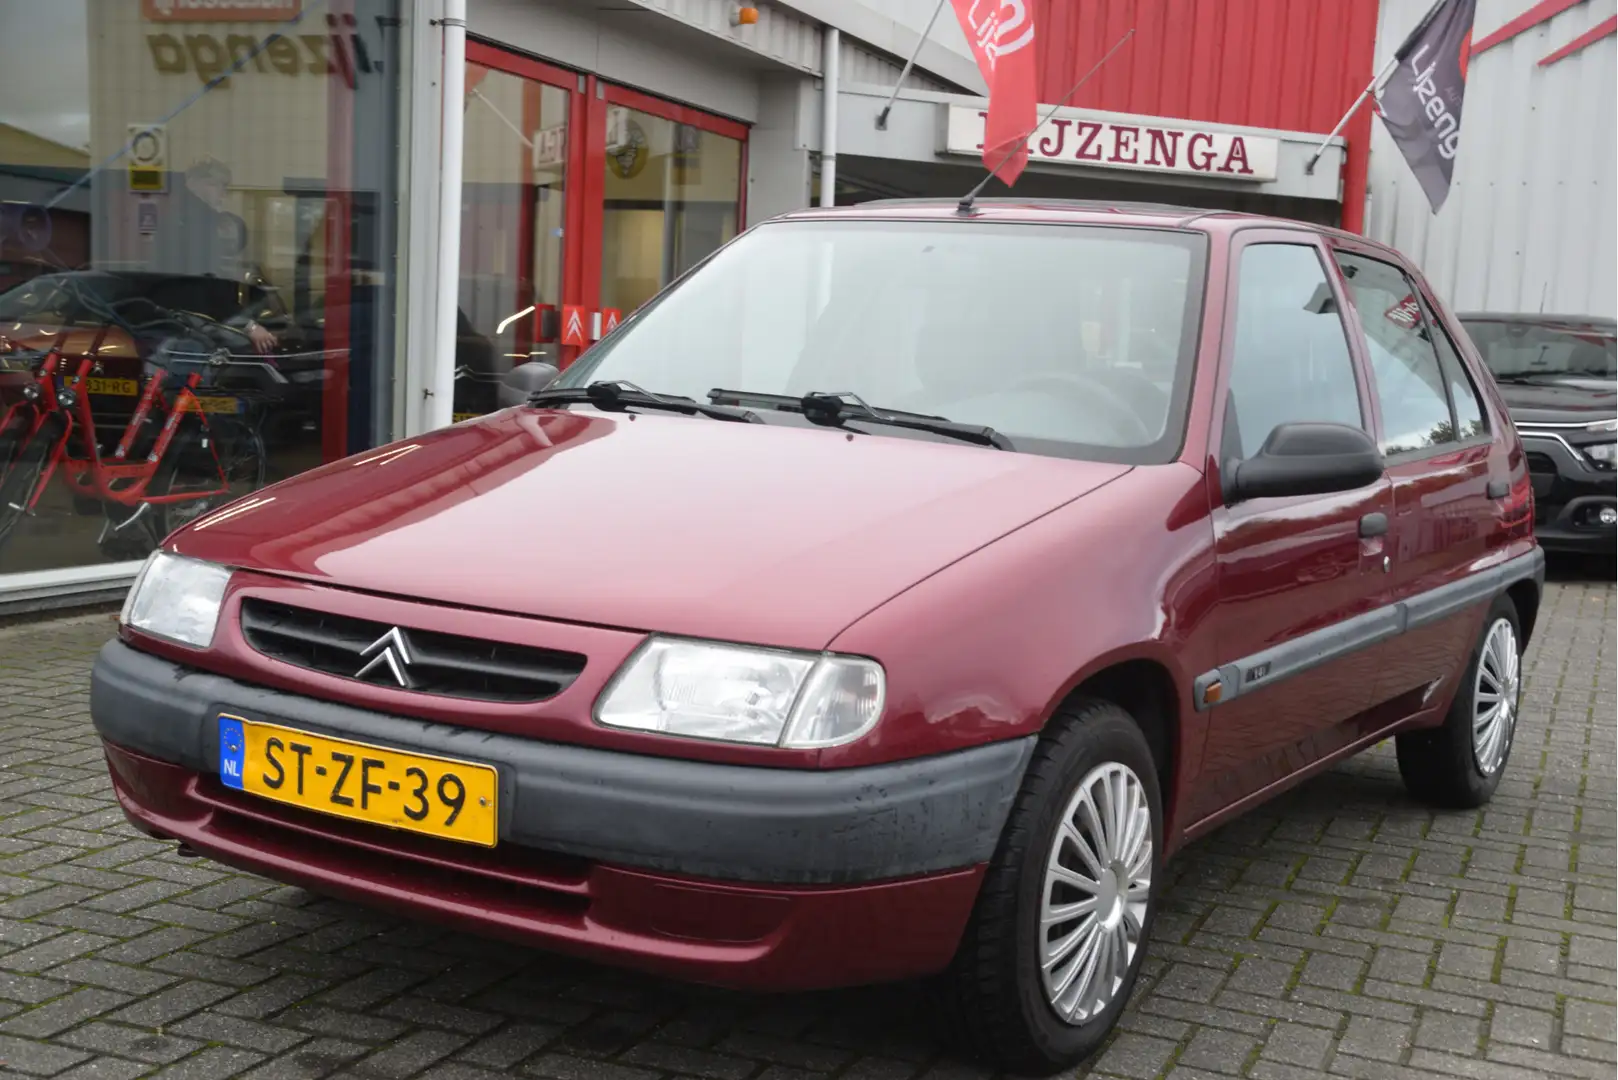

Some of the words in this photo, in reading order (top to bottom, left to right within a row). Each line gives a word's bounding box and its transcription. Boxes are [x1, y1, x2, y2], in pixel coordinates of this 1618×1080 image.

[1411, 44, 1461, 160] Lijzeng
[977, 112, 1254, 175] JZENGA
[223, 759, 240, 777] NL
[262, 737, 467, 827] ST-ZF-39
